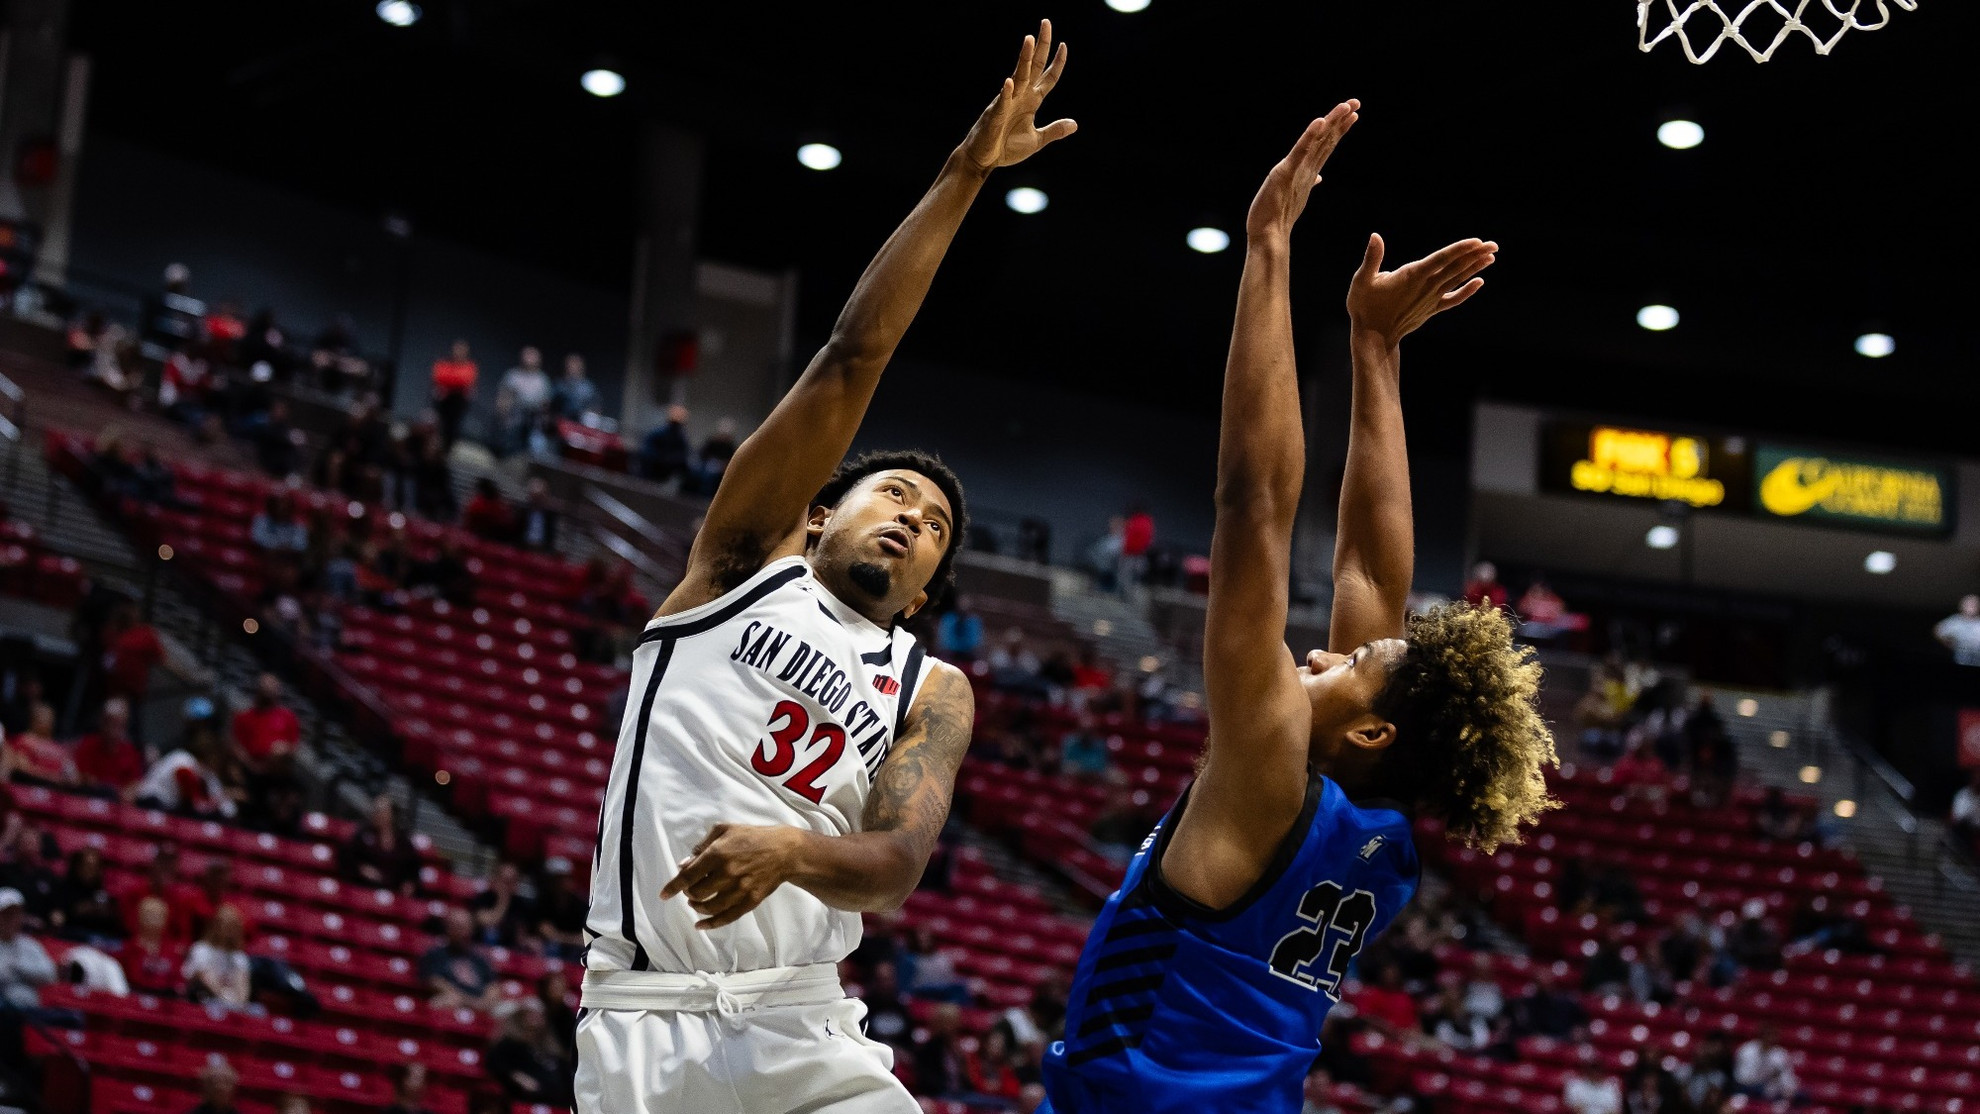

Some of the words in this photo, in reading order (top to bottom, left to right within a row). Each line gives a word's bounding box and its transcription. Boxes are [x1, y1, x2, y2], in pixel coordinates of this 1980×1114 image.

[730, 620, 792, 673] SAN
[776, 640, 853, 715] DIEGO
[751, 699, 846, 806] 32
